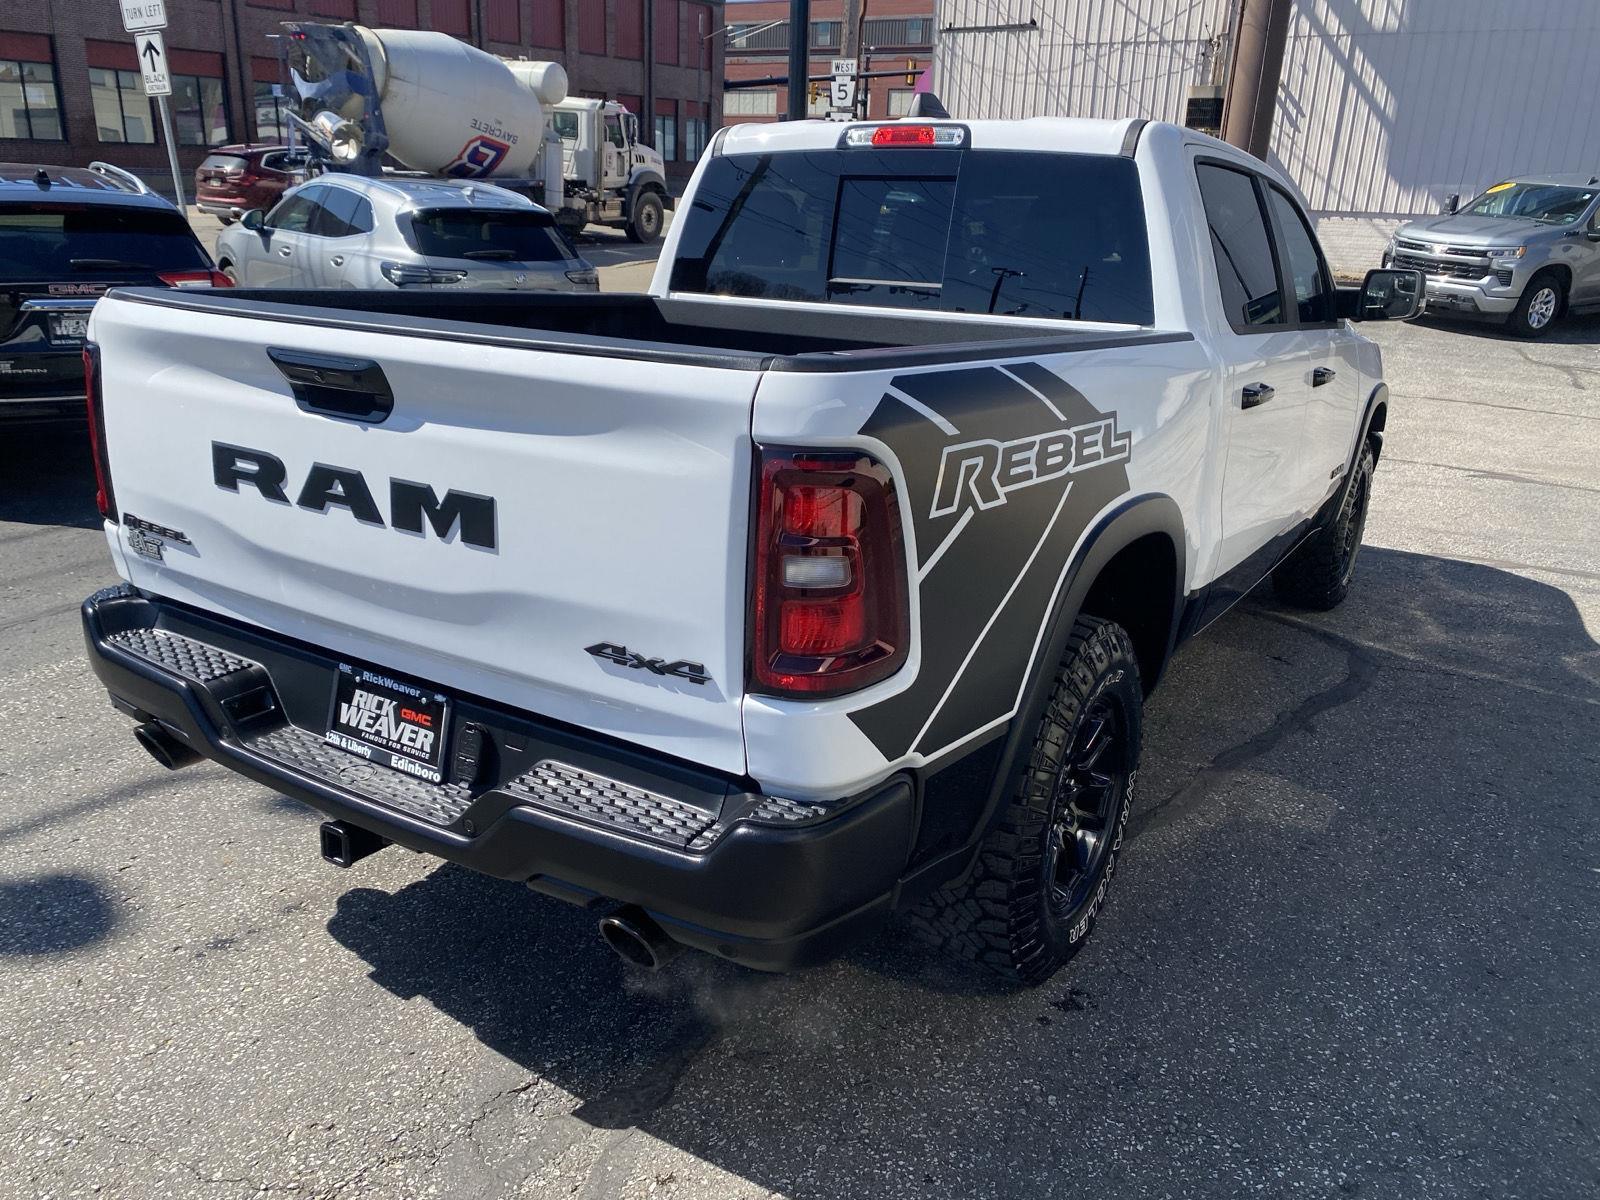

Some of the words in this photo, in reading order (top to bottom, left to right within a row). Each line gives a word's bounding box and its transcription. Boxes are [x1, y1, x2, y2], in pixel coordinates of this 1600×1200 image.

[125, 8, 142, 19] TURN
[144, 4, 160, 17] LEFT
[145, 73, 166, 84] BLACK
[835, 61, 854, 73] WEST
[837, 83, 848, 100] 5
[470, 118, 519, 145] BAYCRETE
[48, 284, 107, 295] GMC
[928, 417, 1130, 519] REBEL
[211, 440, 496, 549] RAM
[123, 512, 192, 545] REBEL
[339, 662, 353, 674] GMC
[362, 671, 421, 698] RickWeaver
[351, 689, 398, 716] RICK
[339, 702, 435, 753] WEAVER
[401, 708, 432, 727] GMC
[325, 731, 341, 746] 12th
[340, 737, 348, 748] &
[347, 740, 372, 758] Liberty
[361, 731, 388, 746] FAMOUS
[388, 740, 402, 750] FOR
[402, 745, 430, 760] SERVICE
[390, 754, 442, 782] Edinboro
